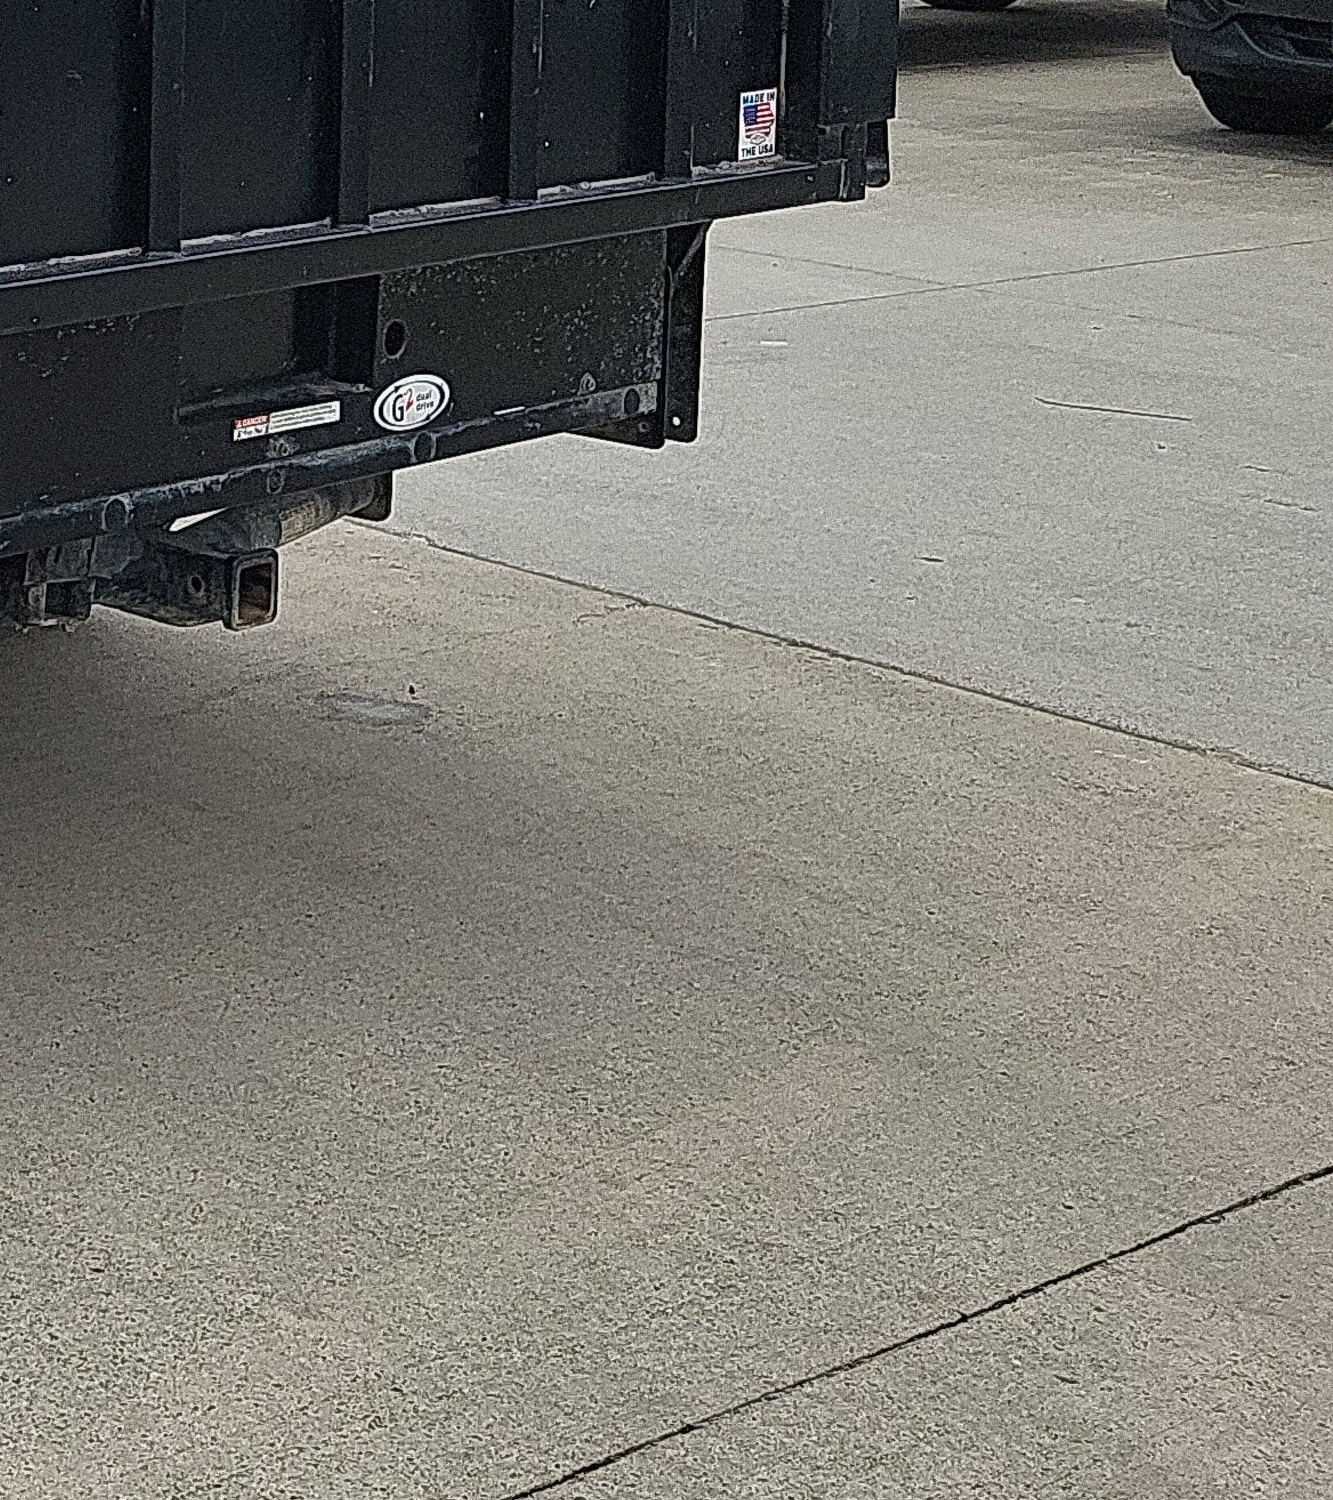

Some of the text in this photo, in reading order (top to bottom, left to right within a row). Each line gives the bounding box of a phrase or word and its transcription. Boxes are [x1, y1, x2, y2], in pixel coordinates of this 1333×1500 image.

[742, 91, 776, 104] MADE IN
[741, 143, 773, 158] THE USA
[416, 390, 432, 401] dual
[416, 401, 434, 412] drive
